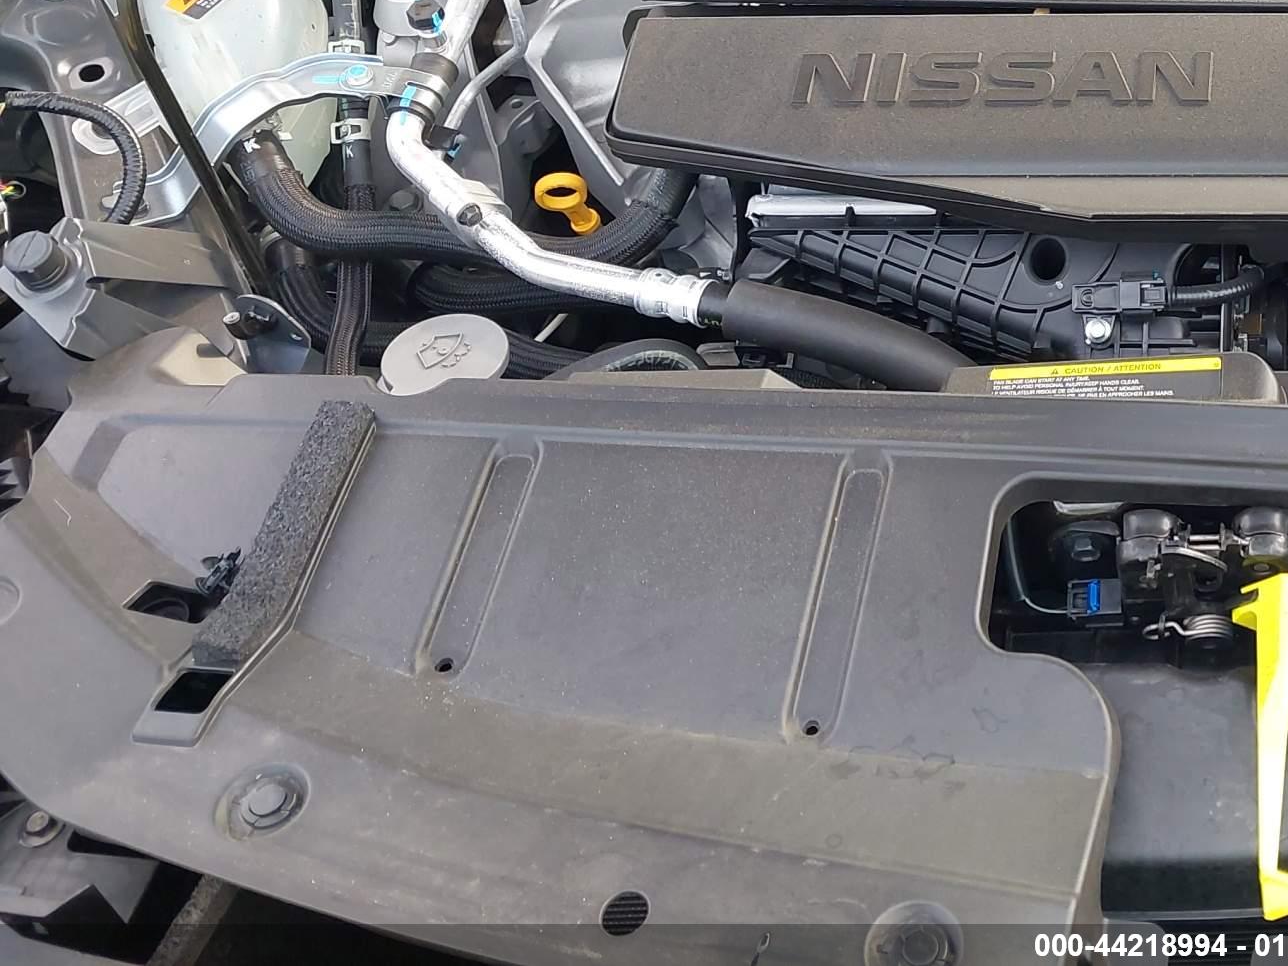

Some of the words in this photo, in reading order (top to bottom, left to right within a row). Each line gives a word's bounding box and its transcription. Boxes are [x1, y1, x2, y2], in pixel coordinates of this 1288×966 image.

[791, 50, 1214, 107] NISSAN
[243, 138, 261, 154] K
[346, 145, 354, 159] K
[1065, 365, 1104, 375] CAUTION
[1113, 363, 1161, 372] ATTENTION
